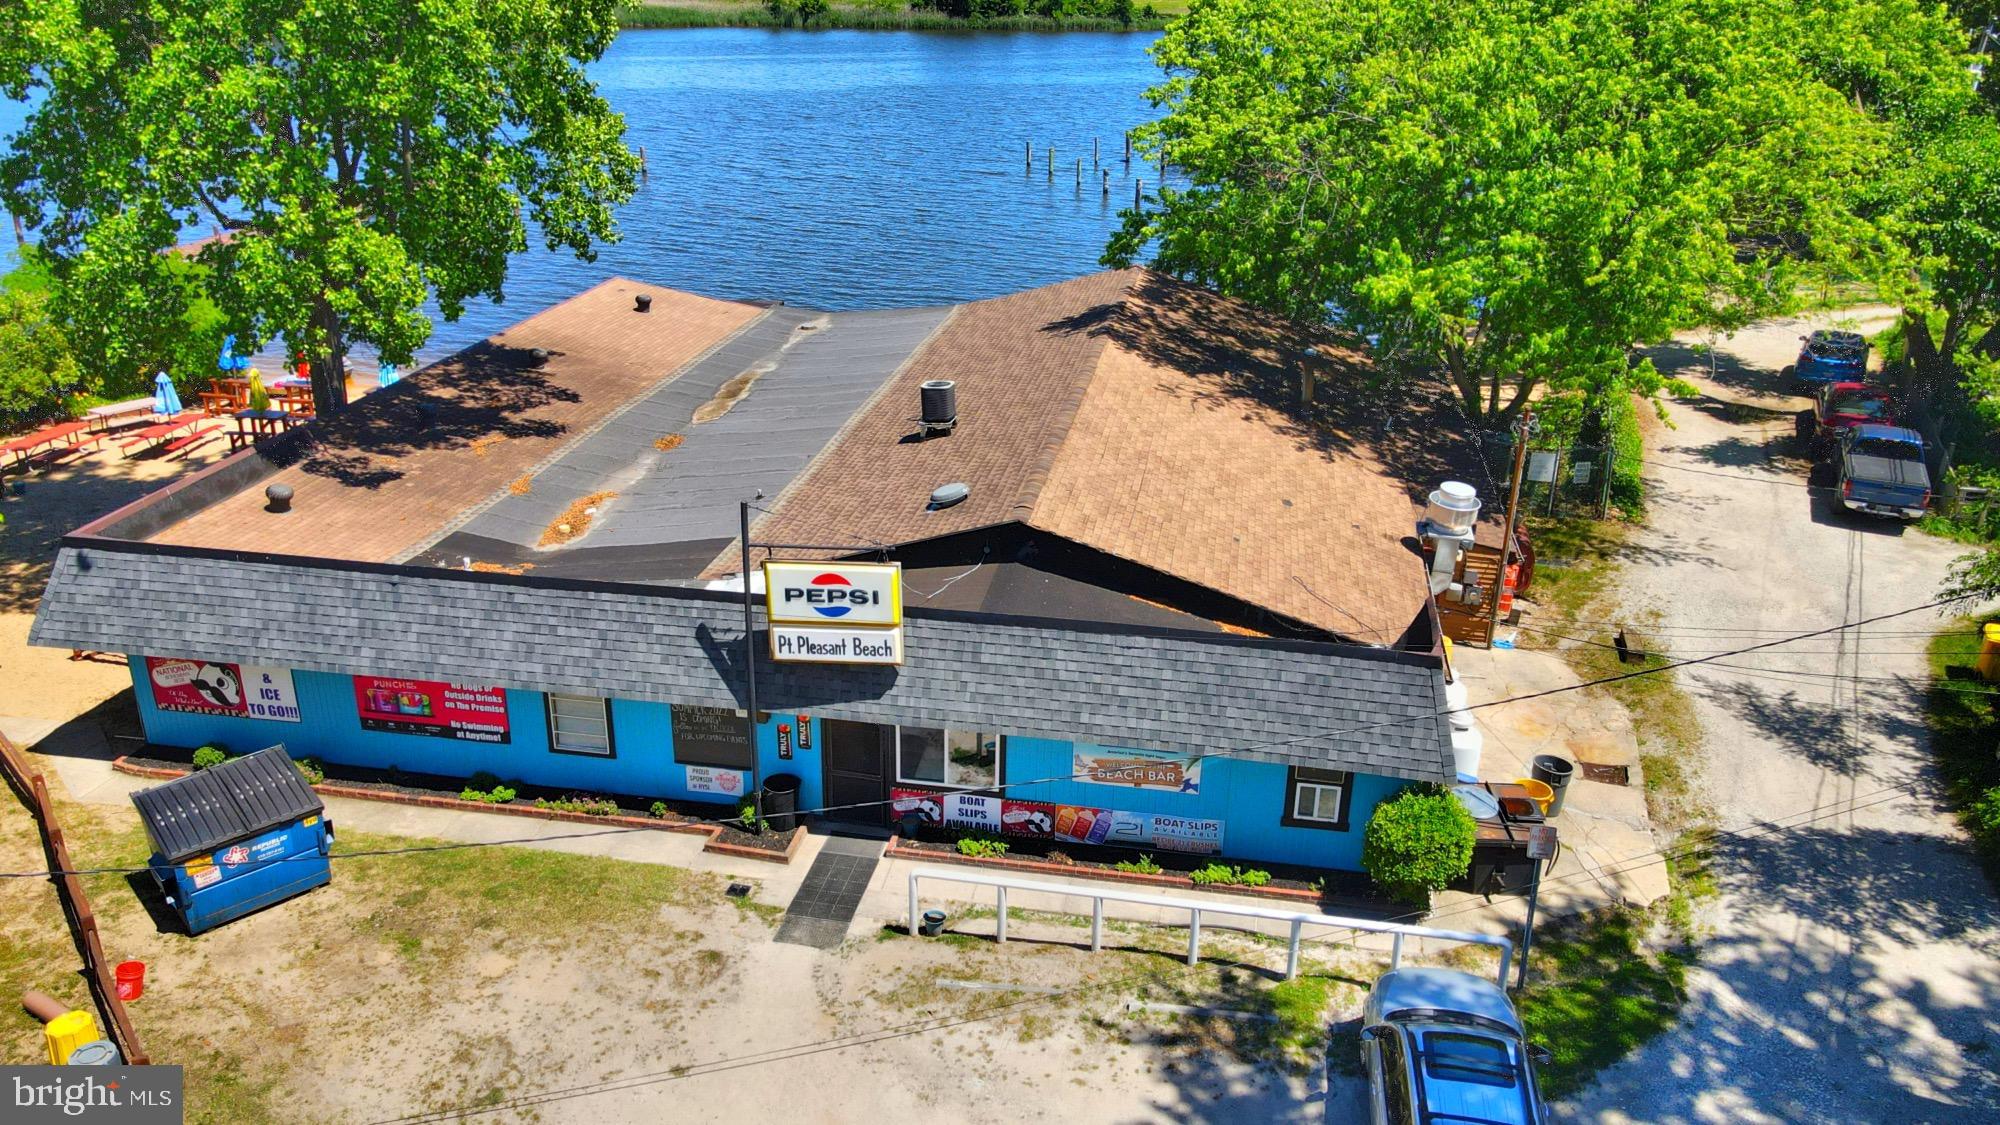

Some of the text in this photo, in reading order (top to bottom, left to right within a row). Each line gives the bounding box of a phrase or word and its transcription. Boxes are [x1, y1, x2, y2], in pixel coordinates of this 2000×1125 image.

[784, 588, 879, 605] PEPSI
[778, 635, 892, 657] Pt. Pleasant Beach
[155, 663, 193, 676] NATIONAL
[262, 673, 272, 684] &
[373, 680, 405, 689] PUNCH
[260, 688, 281, 701] ICE
[445, 691, 503, 703] Outside Drinks
[249, 703, 299, 719] TO GO!!!
[456, 702, 470, 710] The
[471, 703, 505, 713] Premise
[450, 720, 461, 728] No
[462, 722, 505, 734] Swimming
[780, 732, 788, 756] TRULY
[690, 775, 713, 783] SPONSOR
[1098, 768, 1176, 782] BEACH BAR
[960, 796, 986, 807] BOAT
[958, 808, 987, 820] SLIPS
[945, 819, 1000, 832] AVAILABLE
[1154, 817, 1185, 828] BOAT
[1188, 821, 1218, 831] SLIPS
[1154, 827, 1218, 838] AVAILABLE
